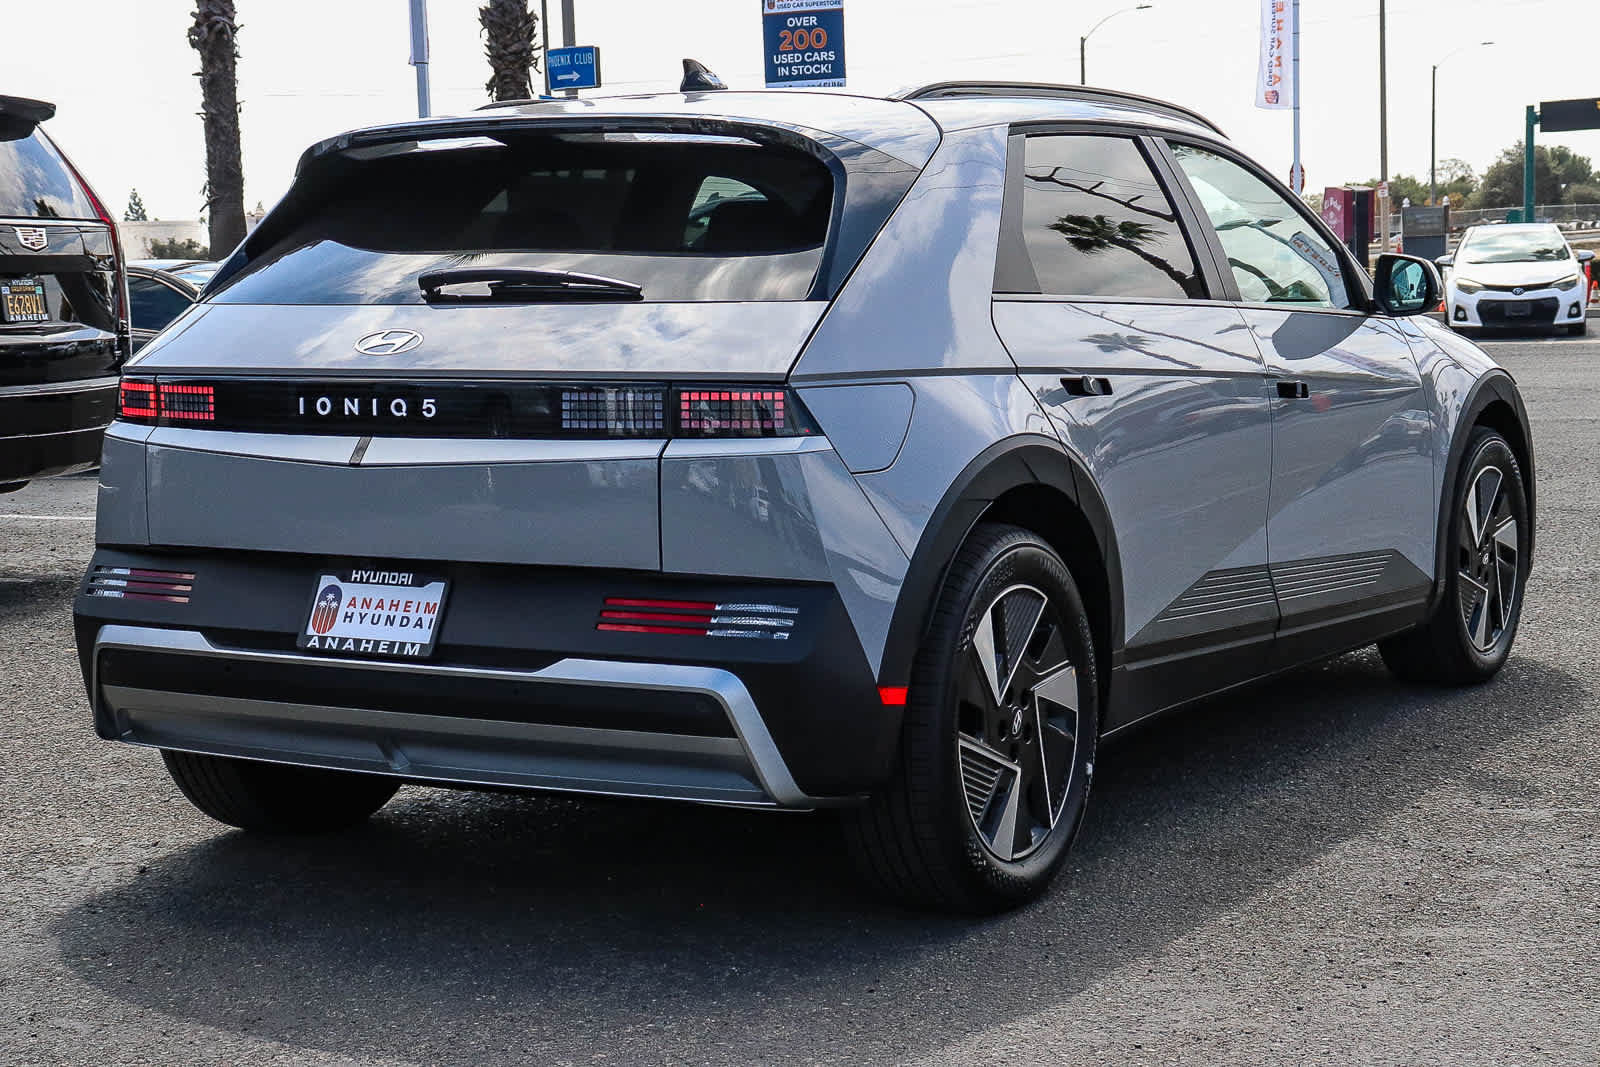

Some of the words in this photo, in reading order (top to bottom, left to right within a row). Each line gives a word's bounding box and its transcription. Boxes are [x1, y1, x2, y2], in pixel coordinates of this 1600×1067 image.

[805, 0, 841, 8] SUPERSTORE
[787, 16, 818, 27] OVER
[779, 27, 828, 51] 200
[574, 52, 593, 65] CLUB
[773, 53, 802, 64] USED
[804, 51, 836, 62] CARS
[777, 66, 789, 76] IN
[791, 63, 832, 75] STOCK!
[9, 313, 49, 321] ANAHEIM
[298, 396, 407, 417] IONIQ
[422, 398, 437, 418] 5
[351, 569, 413, 585] HYUNDAI
[346, 596, 438, 615] ANAHEIM
[342, 611, 434, 630] HYUNDAI
[306, 635, 421, 656] ANAHEIM
